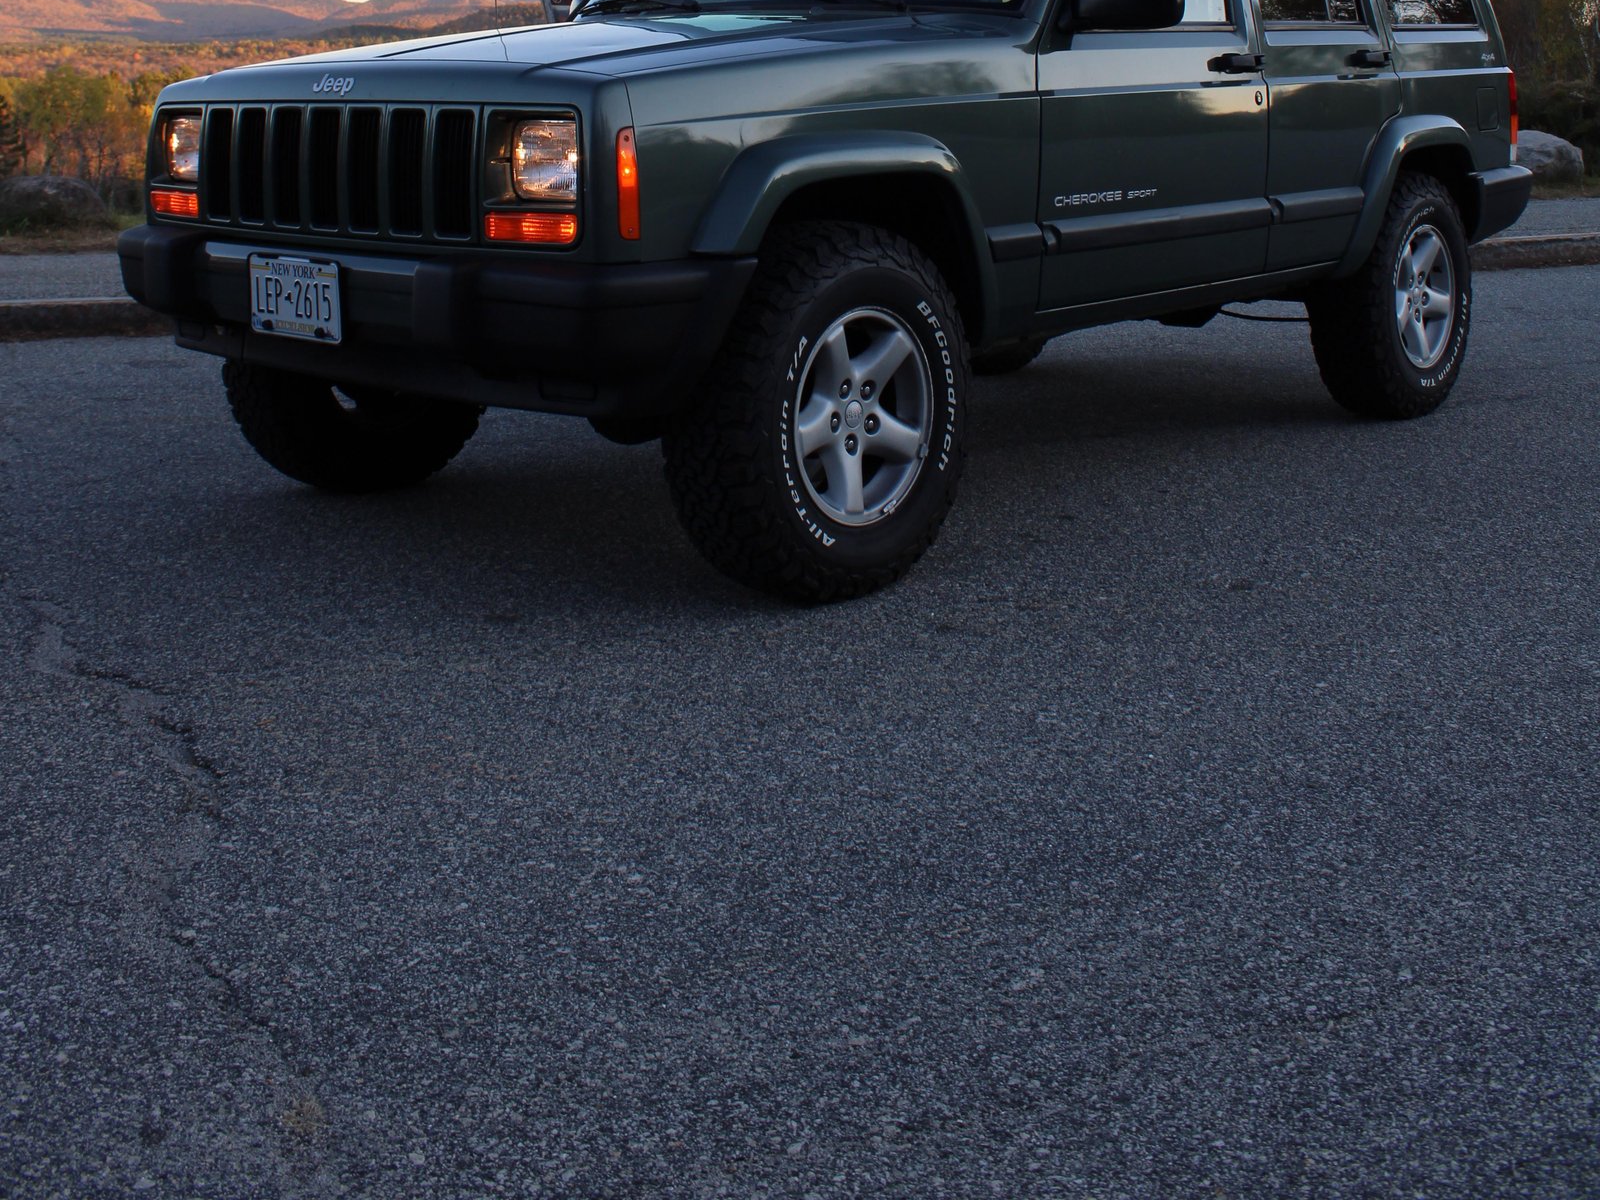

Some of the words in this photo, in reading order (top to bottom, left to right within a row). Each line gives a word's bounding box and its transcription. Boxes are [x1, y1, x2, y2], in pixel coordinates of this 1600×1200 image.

[313, 73, 355, 95] Jeep
[1054, 190, 1122, 207] CHEROKEE
[1127, 188, 1157, 199] SPORT
[271, 262, 291, 275] NEW
[292, 265, 316, 279] YORK
[256, 275, 283, 315] LEP
[294, 279, 331, 322] 2615
[787, 336, 808, 382] T/A
[917, 300, 957, 471] BFGoodrich
